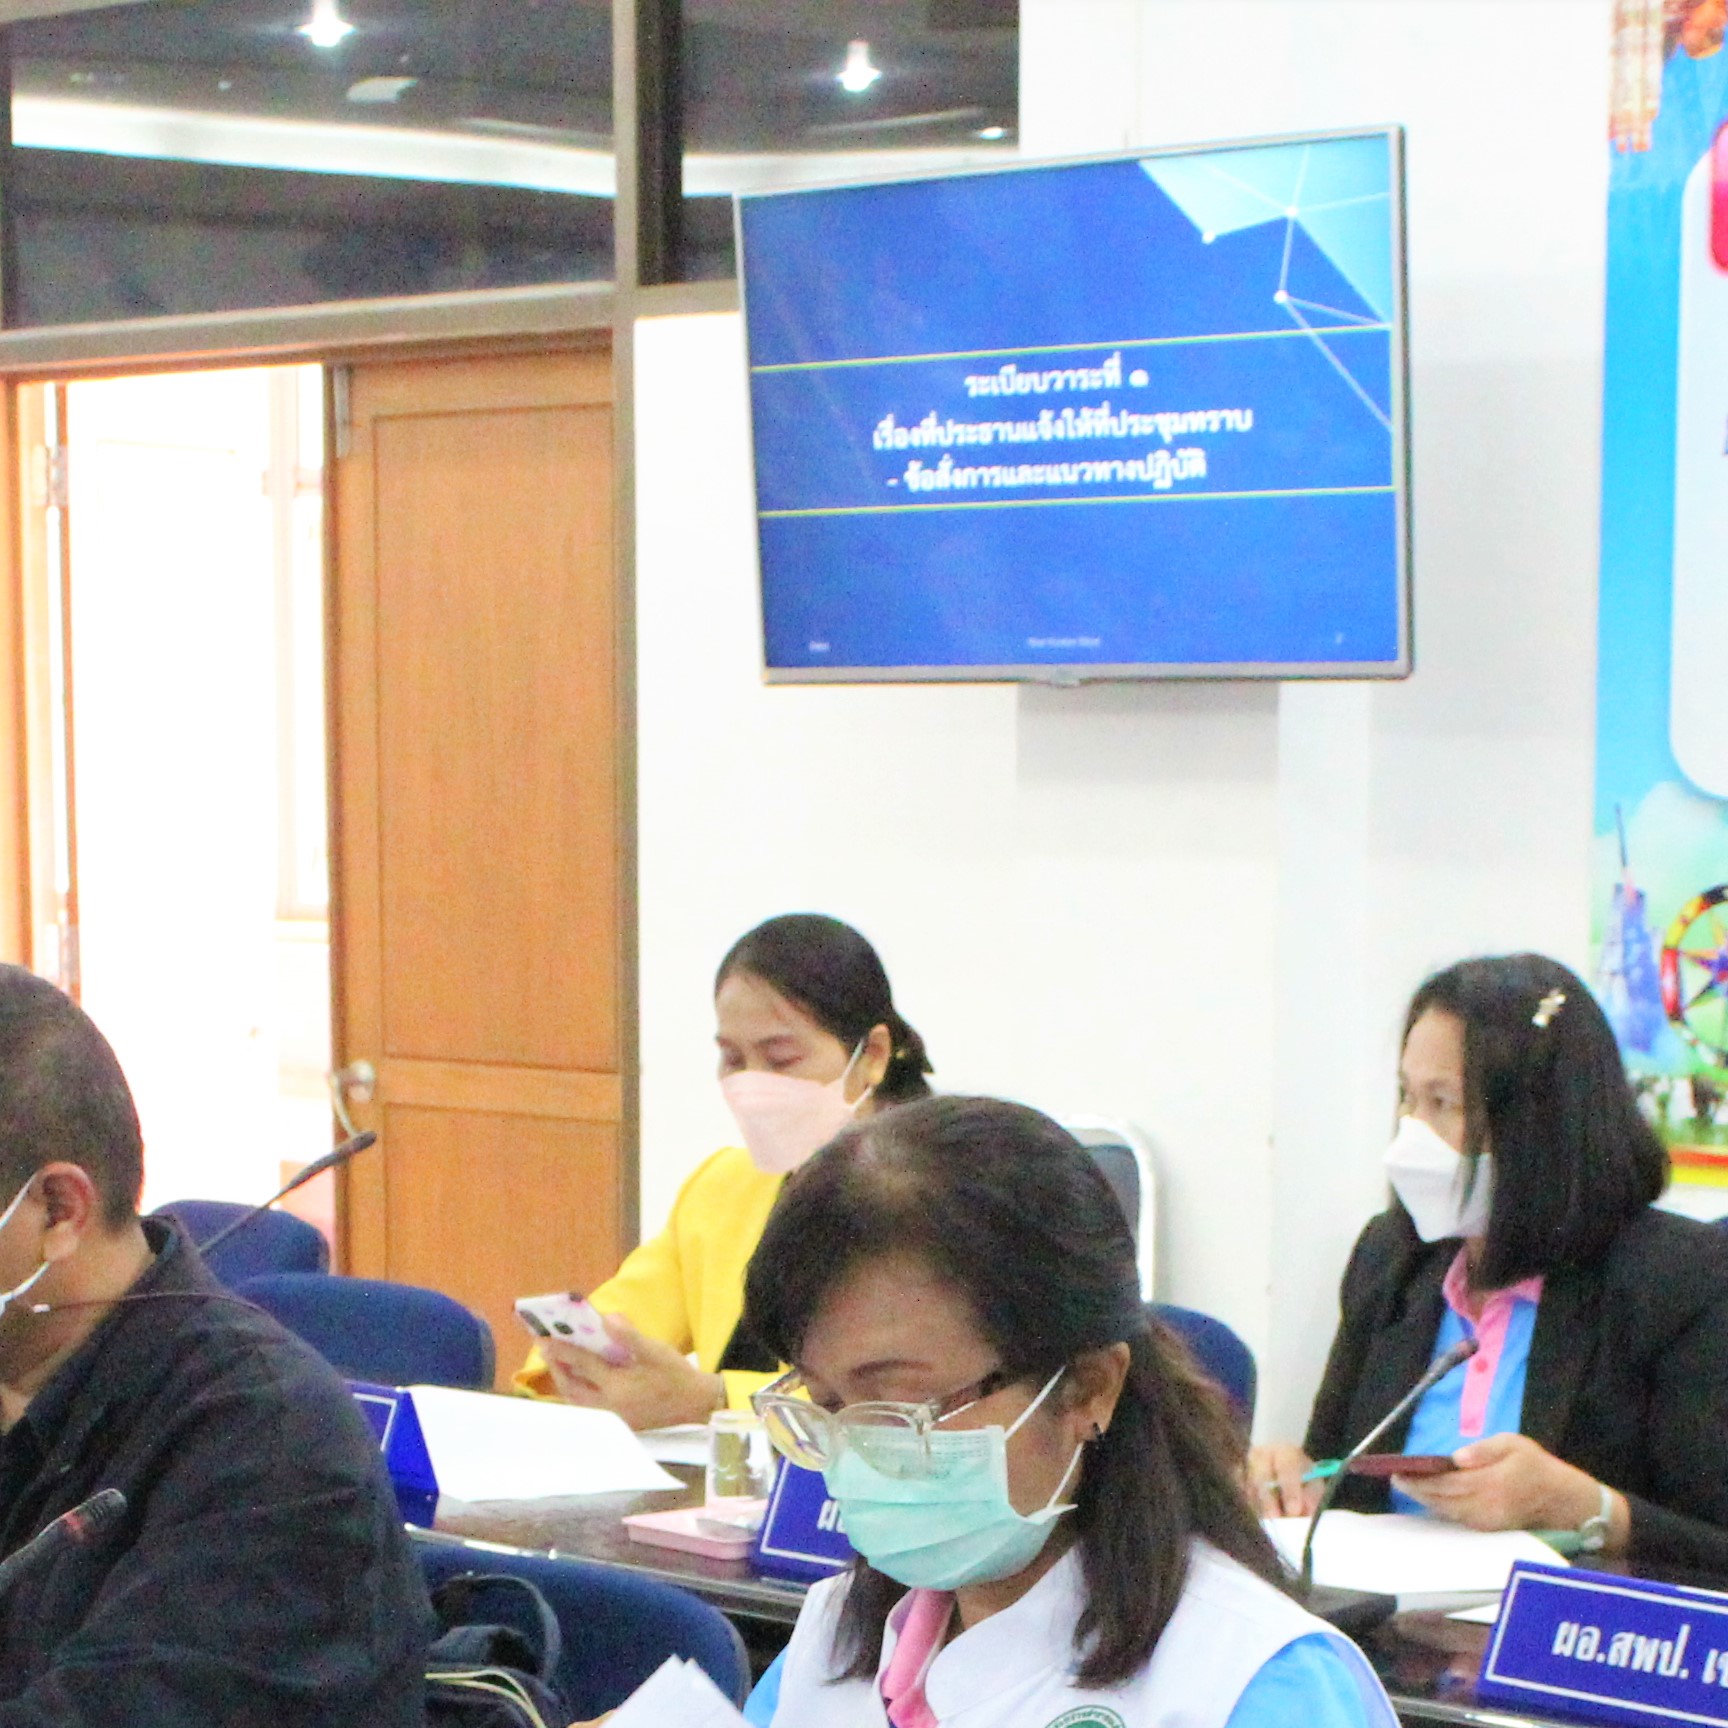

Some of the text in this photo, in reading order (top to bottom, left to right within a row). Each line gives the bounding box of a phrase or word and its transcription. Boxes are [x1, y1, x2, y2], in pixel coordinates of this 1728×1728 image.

[963, 351, 1122, 398] ระเบียบวาระที่
[872, 401, 1254, 450] เรื่องที่ประธานแจ้งให้ที่ประชุมทราบ
[903, 448, 1208, 492] ข้อสั่งการและแนวทางปฏิบัติ
[1551, 1619, 1690, 1680] ผอ.สพป.
